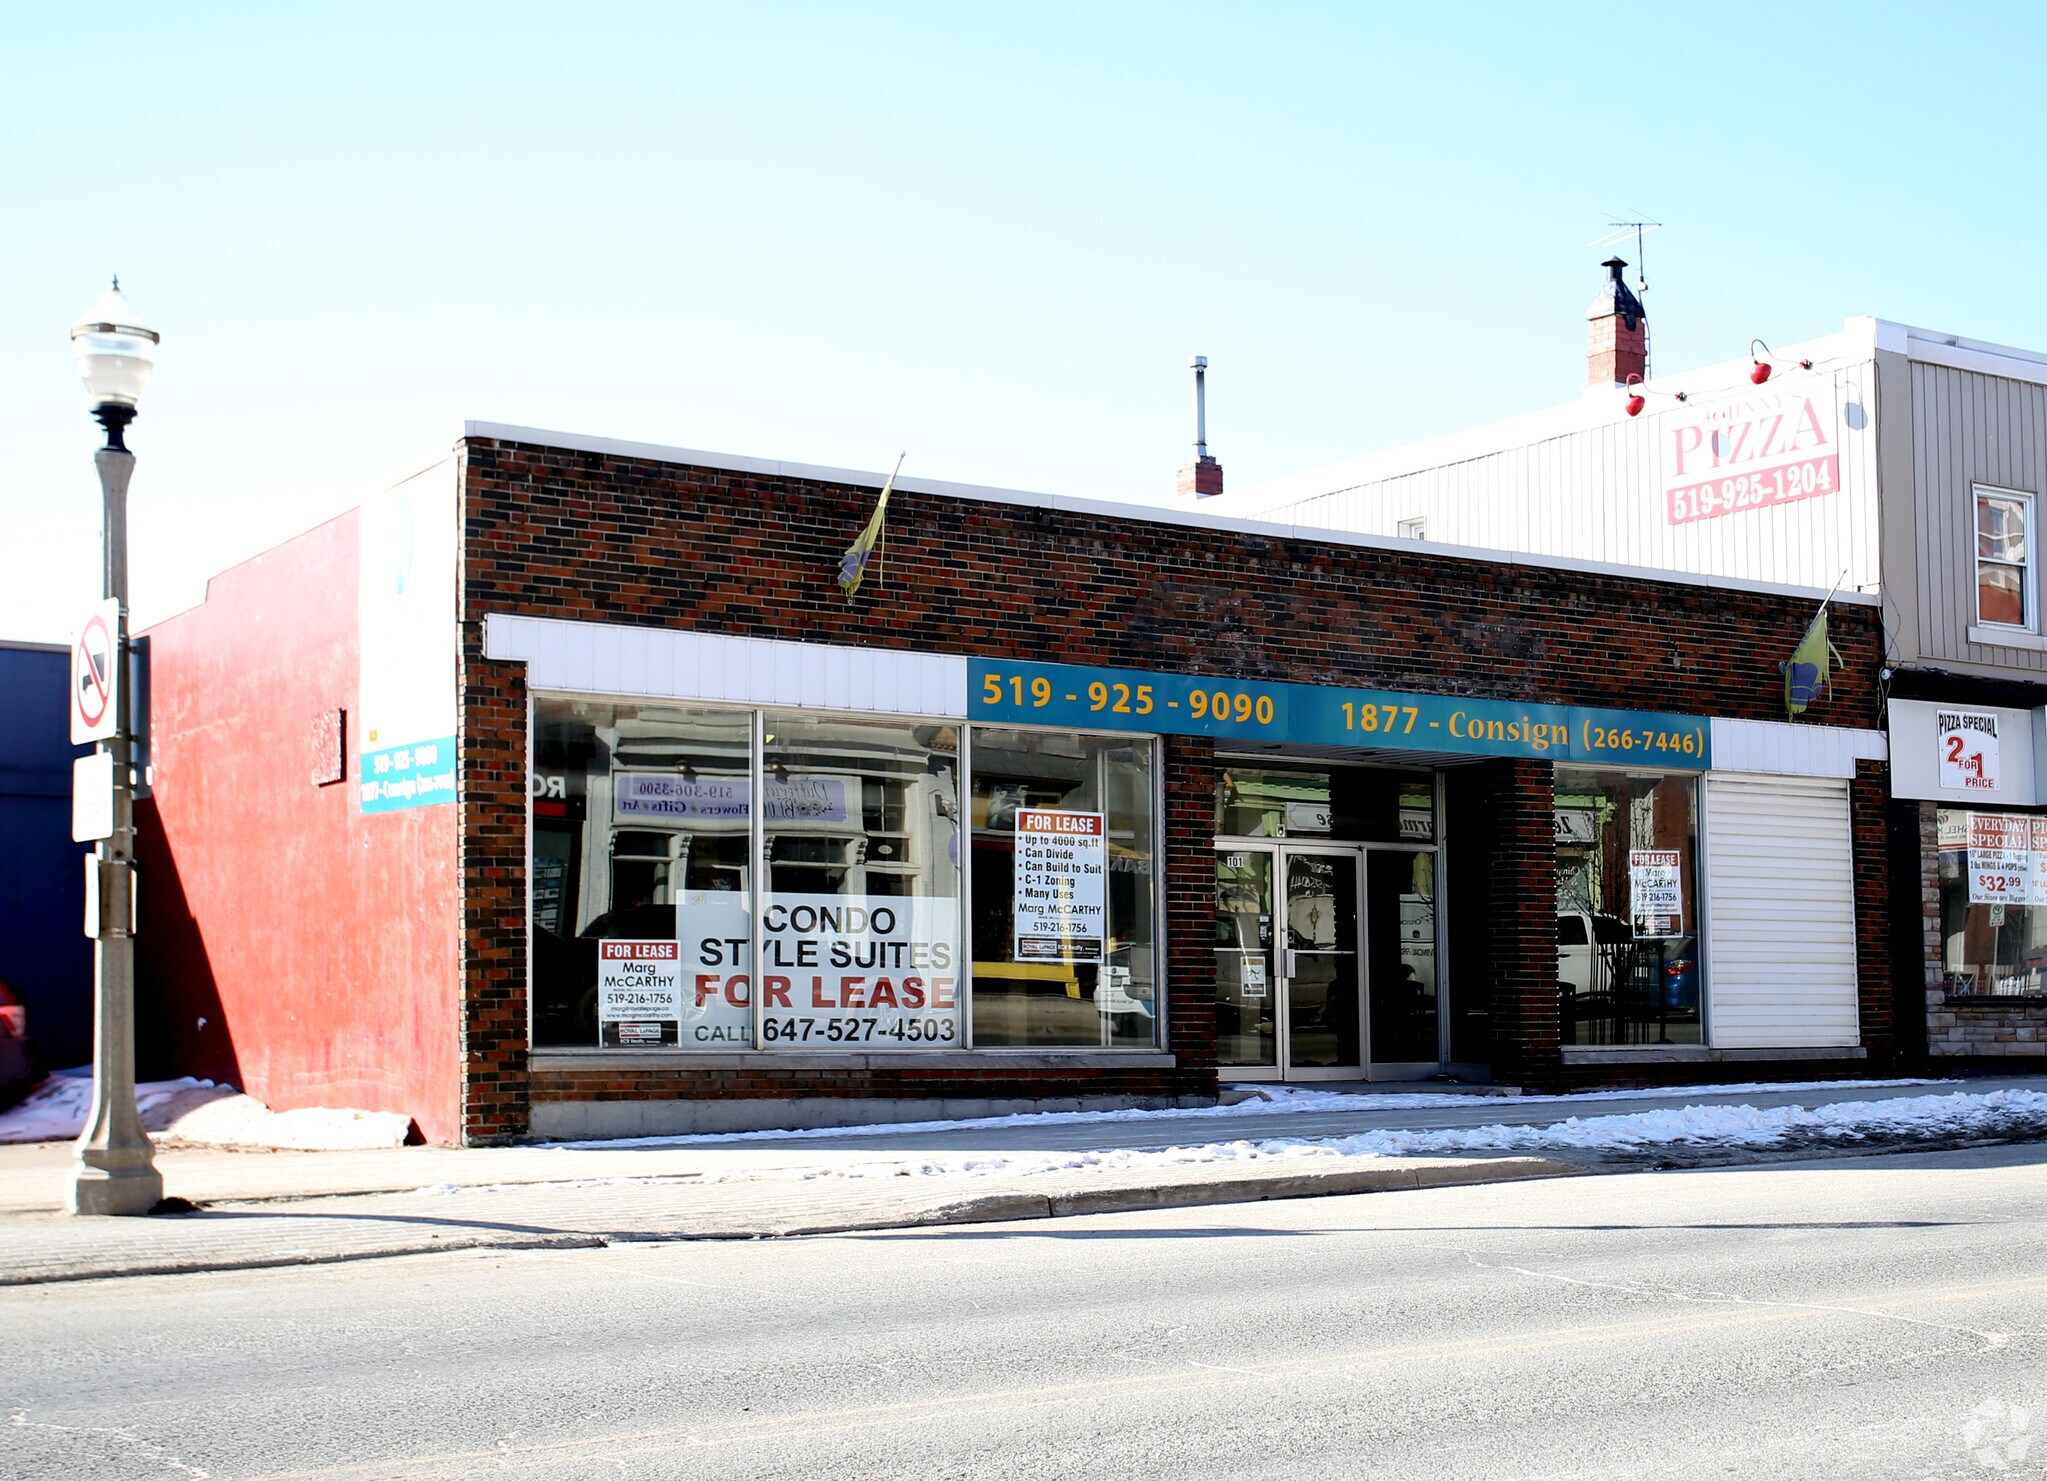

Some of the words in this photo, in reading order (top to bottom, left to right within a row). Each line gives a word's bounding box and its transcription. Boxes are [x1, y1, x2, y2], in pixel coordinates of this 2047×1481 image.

[1671, 397, 1829, 478] PIZZA
[1673, 459, 1832, 520] 519-925-1204
[982, 674, 1052, 707] 519
[1088, 681, 1154, 715] 925
[1189, 690, 1275, 724] 9090
[1342, 702, 1419, 735] 1877
[1449, 711, 1569, 750] Consign
[1583, 719, 1704, 758] (266-7446)
[1939, 713, 1962, 736] PIZZA
[1963, 712, 1997, 739] SPECIAL
[1947, 736, 1964, 763] 2
[1958, 759, 1977, 770] FOR
[1970, 752, 1984, 778] 1
[1965, 777, 1994, 789] PRICE
[1026, 814, 1052, 831] FOR
[1055, 816, 1094, 833] LEASE
[1971, 816, 2025, 832] EVERYDAY
[1025, 834, 1038, 846] Up
[1040, 835, 1049, 845] to
[1052, 836, 1075, 847] 4000
[1078, 837, 1099, 849] sq.ft
[1970, 833, 2027, 848] SPECIAL
[1025, 847, 1043, 858] Can
[1046, 849, 1074, 860] Divide
[1634, 854, 1650, 865] FOR
[1650, 854, 1676, 866] LEASE
[1025, 860, 1043, 871] Can
[1046, 861, 1069, 873] Build
[1071, 863, 1081, 873] to
[1083, 864, 1102, 875] Suit
[1227, 856, 1243, 867] 101
[1025, 874, 1041, 885] C-1
[1045, 875, 1075, 888] Zoning
[1025, 887, 1050, 901] Many
[1052, 888, 1074, 900] Uses
[1018, 903, 1044, 915] Marg
[1048, 904, 1102, 916] McCARTHY
[763, 905, 896, 935] CONDO
[1033, 921, 1087, 933] 519-216-1756
[607, 944, 632, 958] FOR
[636, 945, 673, 958] LEASE
[830, 940, 951, 969] SUITES
[622, 962, 656, 975] Marg
[604, 976, 675, 987] McCARTHY
[607, 993, 673, 1004] 519-216-1756
[695, 974, 793, 1008] FOR
[812, 976, 955, 1009] LEASE
[694, 1025, 749, 1042] CALL
[763, 1017, 955, 1042] 647-527-4503
